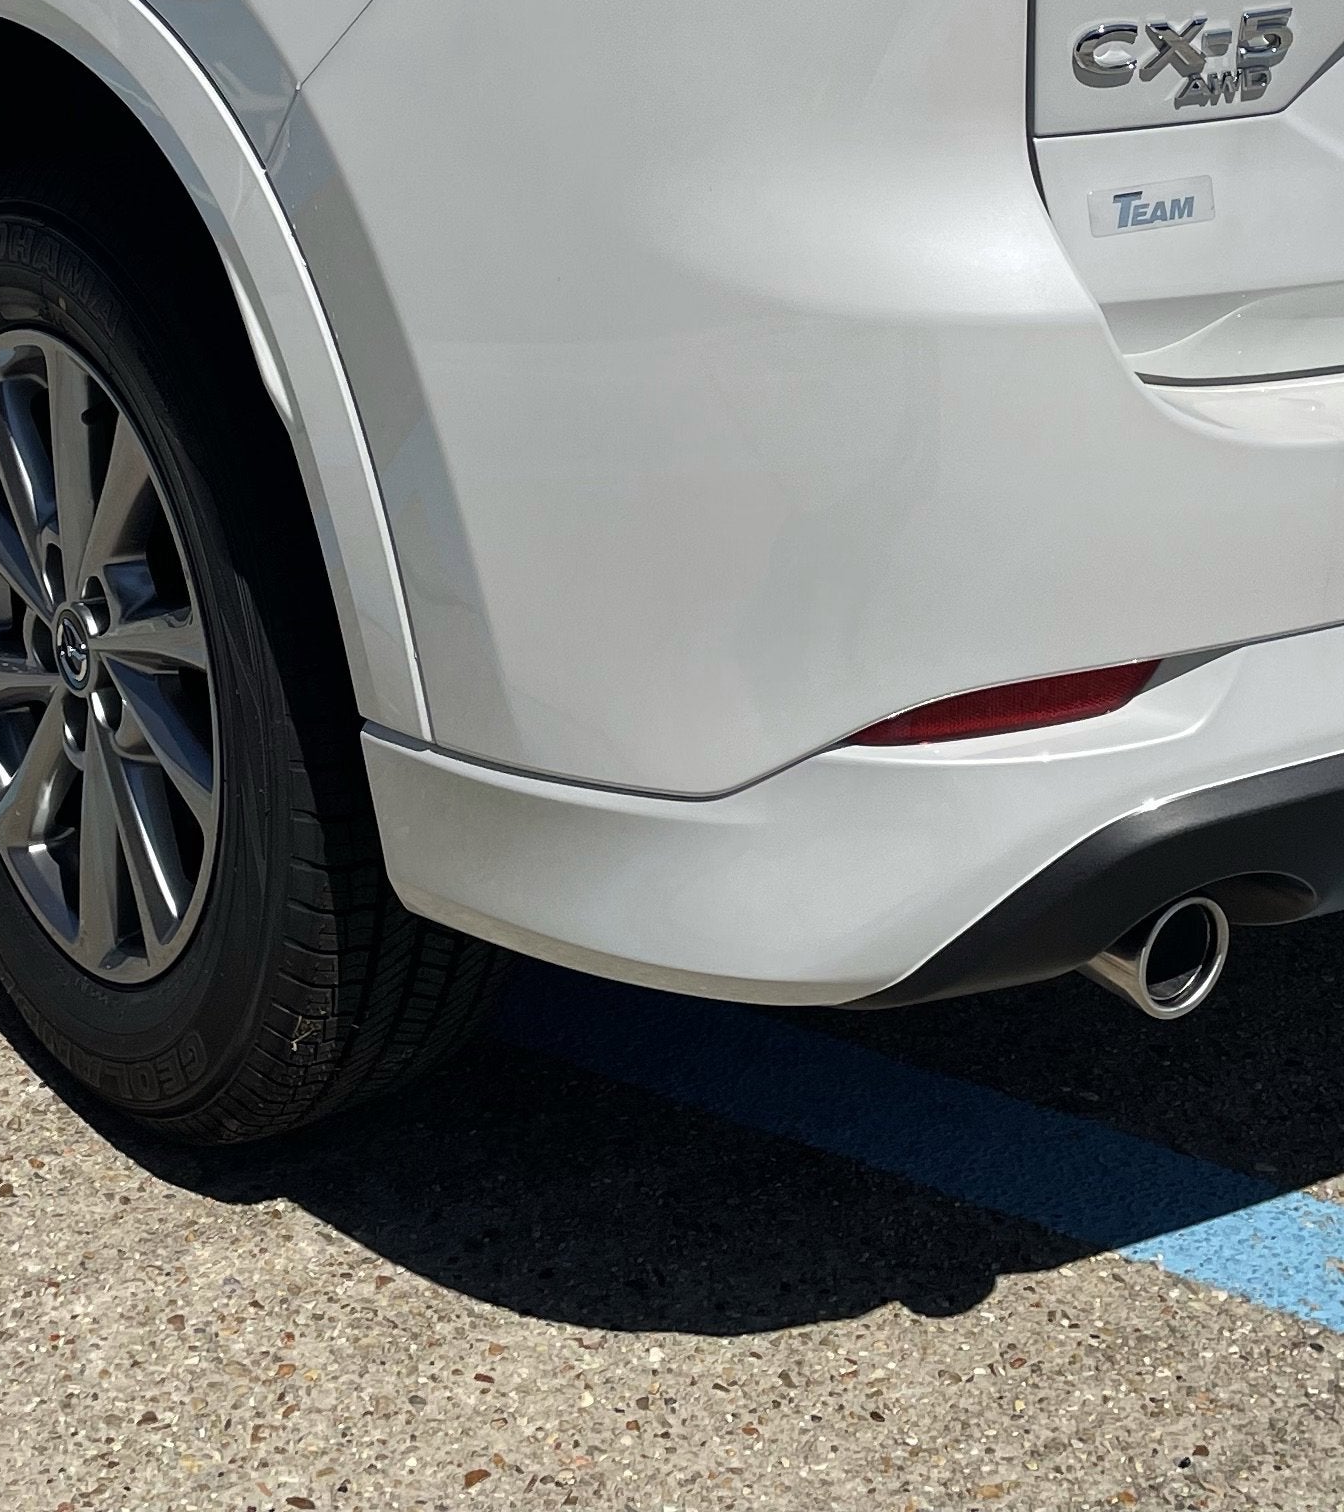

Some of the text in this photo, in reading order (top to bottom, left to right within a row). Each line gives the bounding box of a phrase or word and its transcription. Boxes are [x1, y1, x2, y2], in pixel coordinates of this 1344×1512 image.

[1072, 5, 1294, 89] CX-5
[1173, 67, 1272, 111] AWD
[1113, 190, 1195, 229] TEAM
